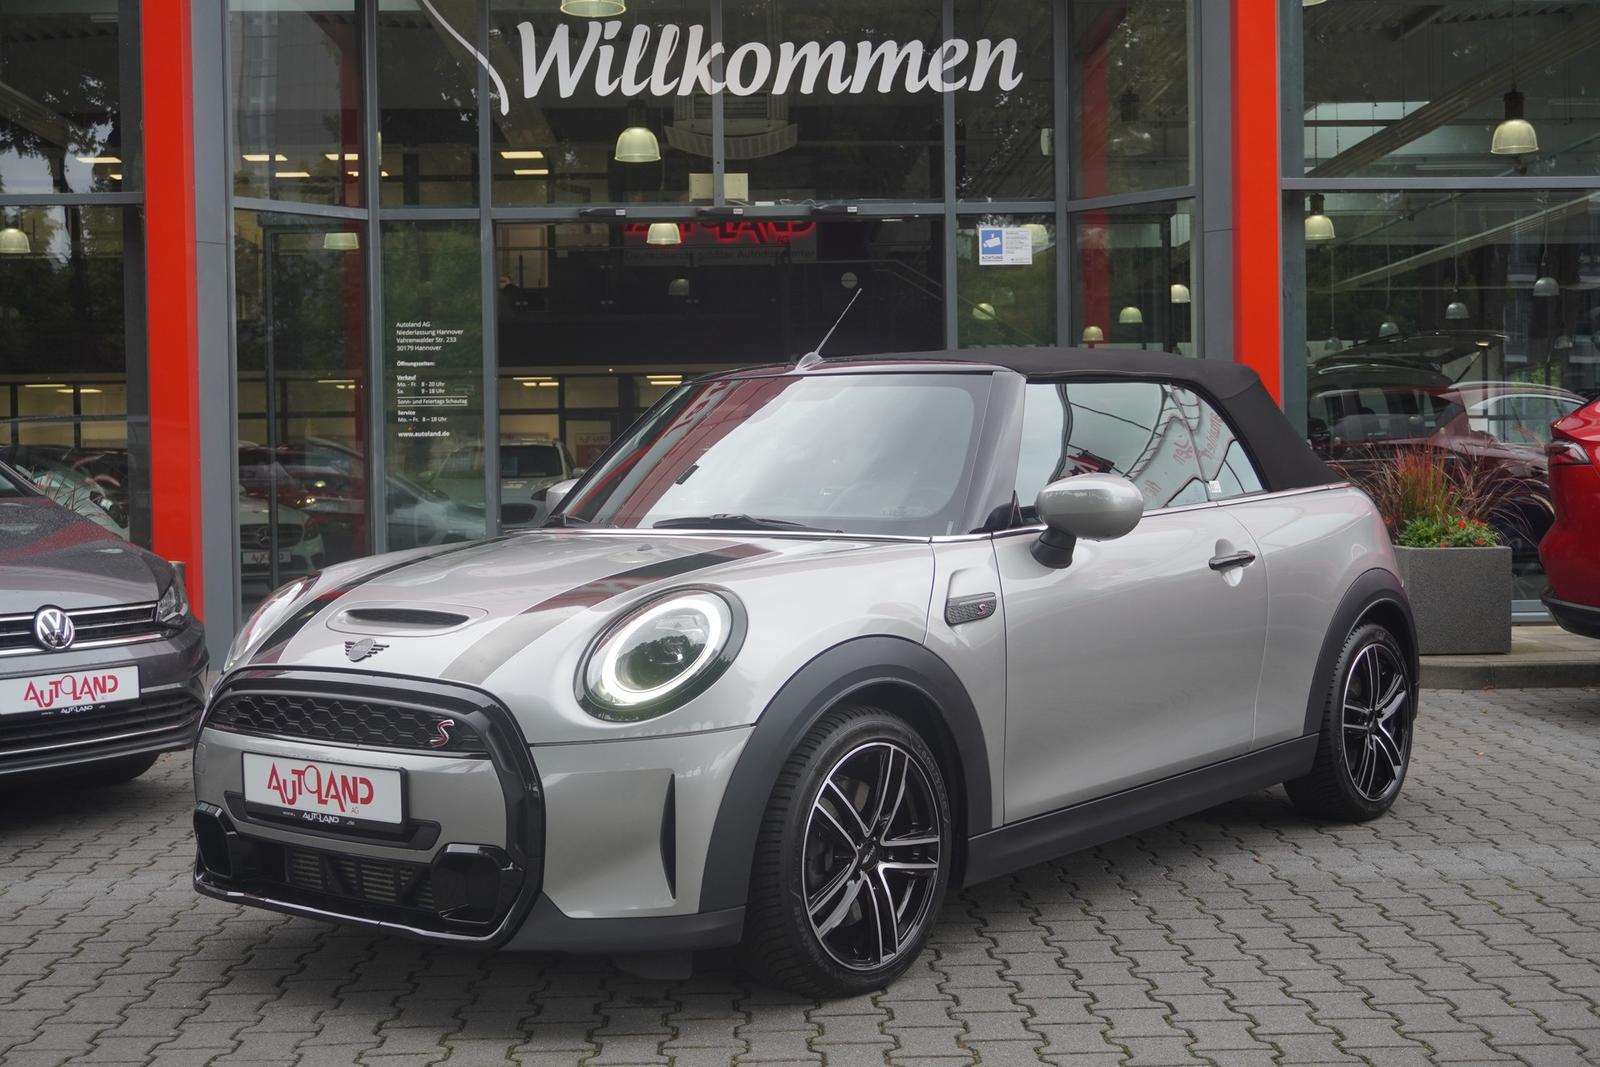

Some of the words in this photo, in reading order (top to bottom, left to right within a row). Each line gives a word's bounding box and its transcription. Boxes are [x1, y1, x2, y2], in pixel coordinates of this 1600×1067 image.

[516, 20, 1024, 99] Willkommen
[24, 674, 119, 708] AUTOLAND
[429, 719, 454, 748] S
[267, 761, 374, 812] AUTOLAND
